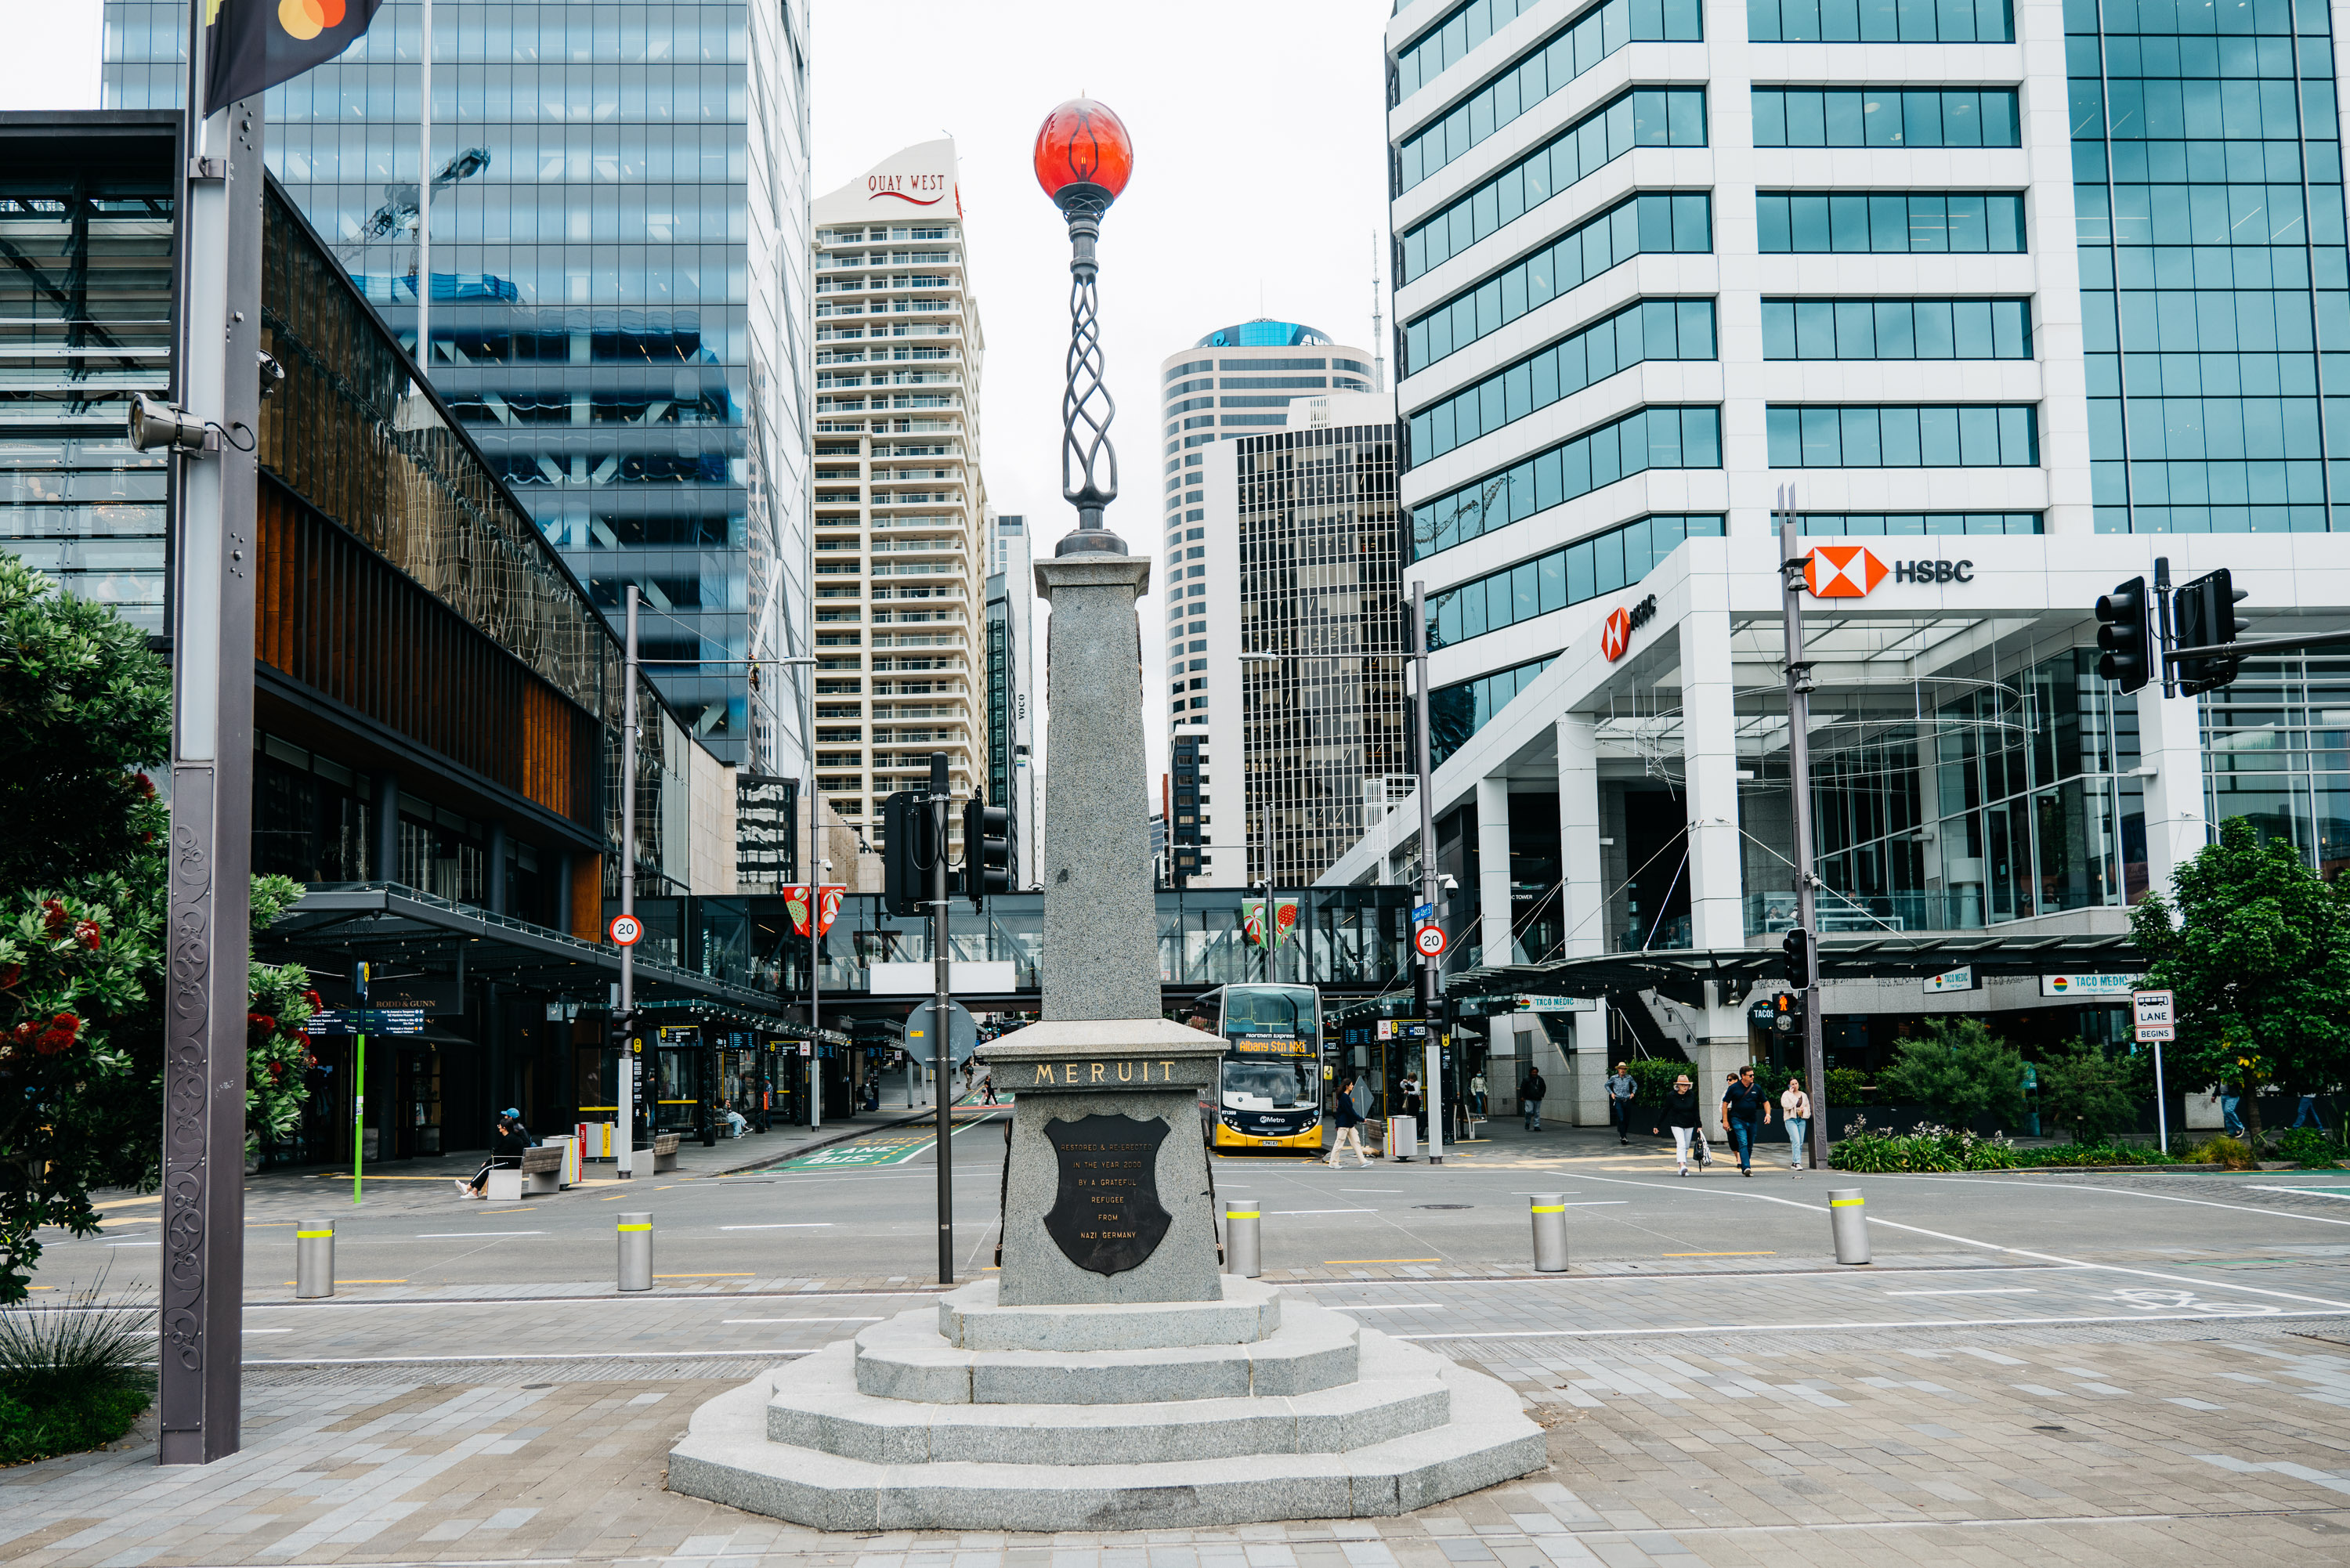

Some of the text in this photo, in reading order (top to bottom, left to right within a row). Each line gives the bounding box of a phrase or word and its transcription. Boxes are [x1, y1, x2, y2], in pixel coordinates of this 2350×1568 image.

[869, 175, 945, 192] QUAY WEST
[1895, 559, 1974, 583] HSBC
[1629, 594, 1657, 630] HSBC
[618, 923, 634, 934] 20
[1423, 935, 1440, 947] 20
[1944, 972, 1969, 984] TACO MEDIC
[2075, 975, 2128, 987] TACO MEDIC
[1535, 997, 1574, 1006] TACO MEDIC
[1754, 1009, 1774, 1018] TACOS
[2140, 1012, 2167, 1021] LANE
[1239, 1040, 1306, 1053] Albany Stn NX1
[1034, 1061, 1175, 1084] MERUIT
[819, 1145, 899, 1157] LANE
[803, 1154, 874, 1165] BUS
